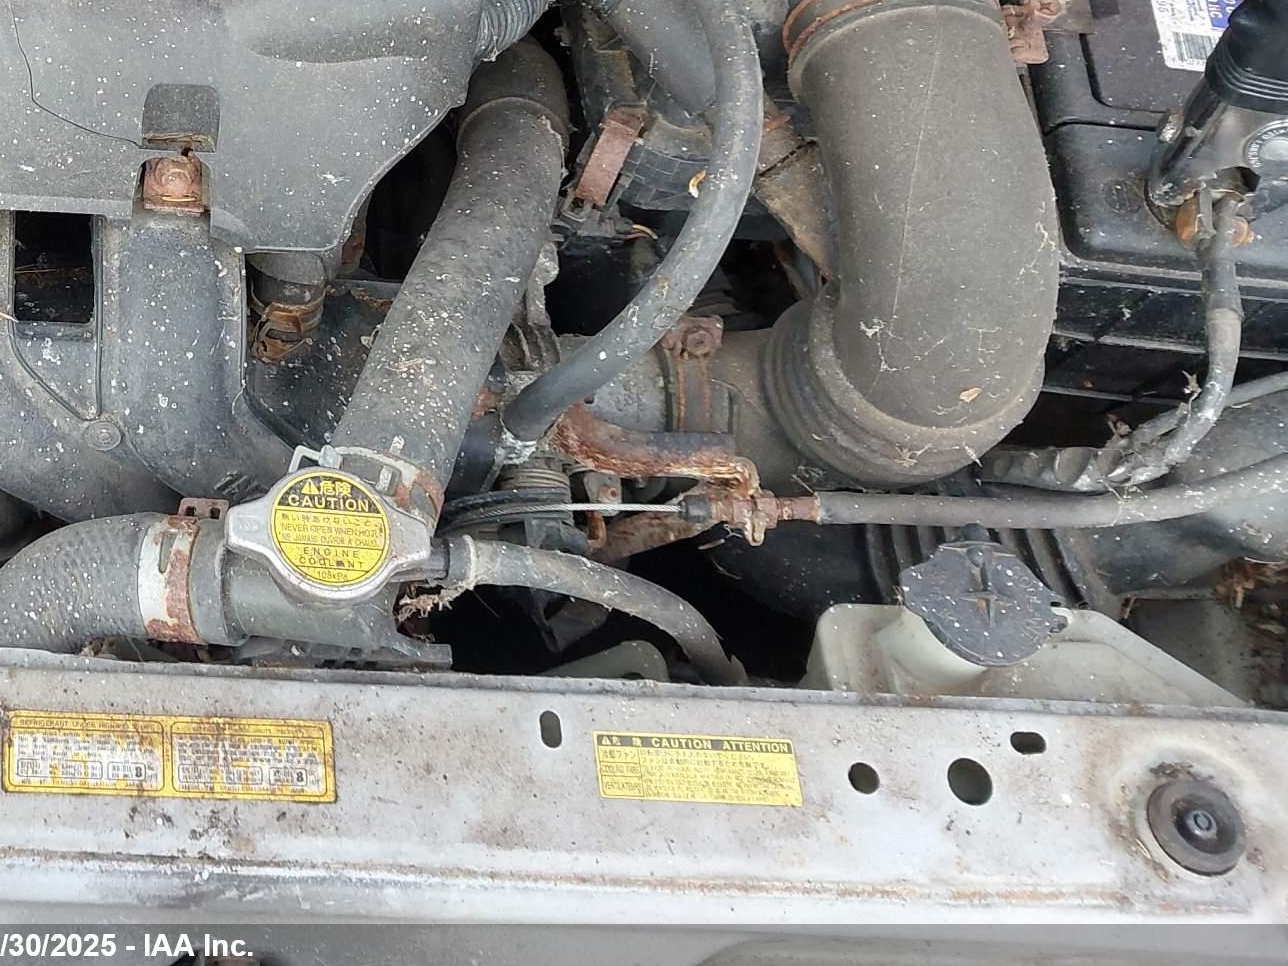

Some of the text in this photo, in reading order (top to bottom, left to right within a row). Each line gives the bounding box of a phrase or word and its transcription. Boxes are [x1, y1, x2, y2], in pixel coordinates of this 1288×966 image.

[320, 480, 352, 497] 危険
[288, 494, 369, 512] CAUTION
[281, 523, 308, 533] NEVER
[310, 525, 333, 534] OPEN
[334, 527, 357, 536] WHEN
[303, 546, 360, 559] ENGINE
[651, 737, 713, 750] CAUTION
[722, 740, 789, 753] ATTENTION
[134, 766, 143, 779] 8
[295, 772, 304, 783] 8
